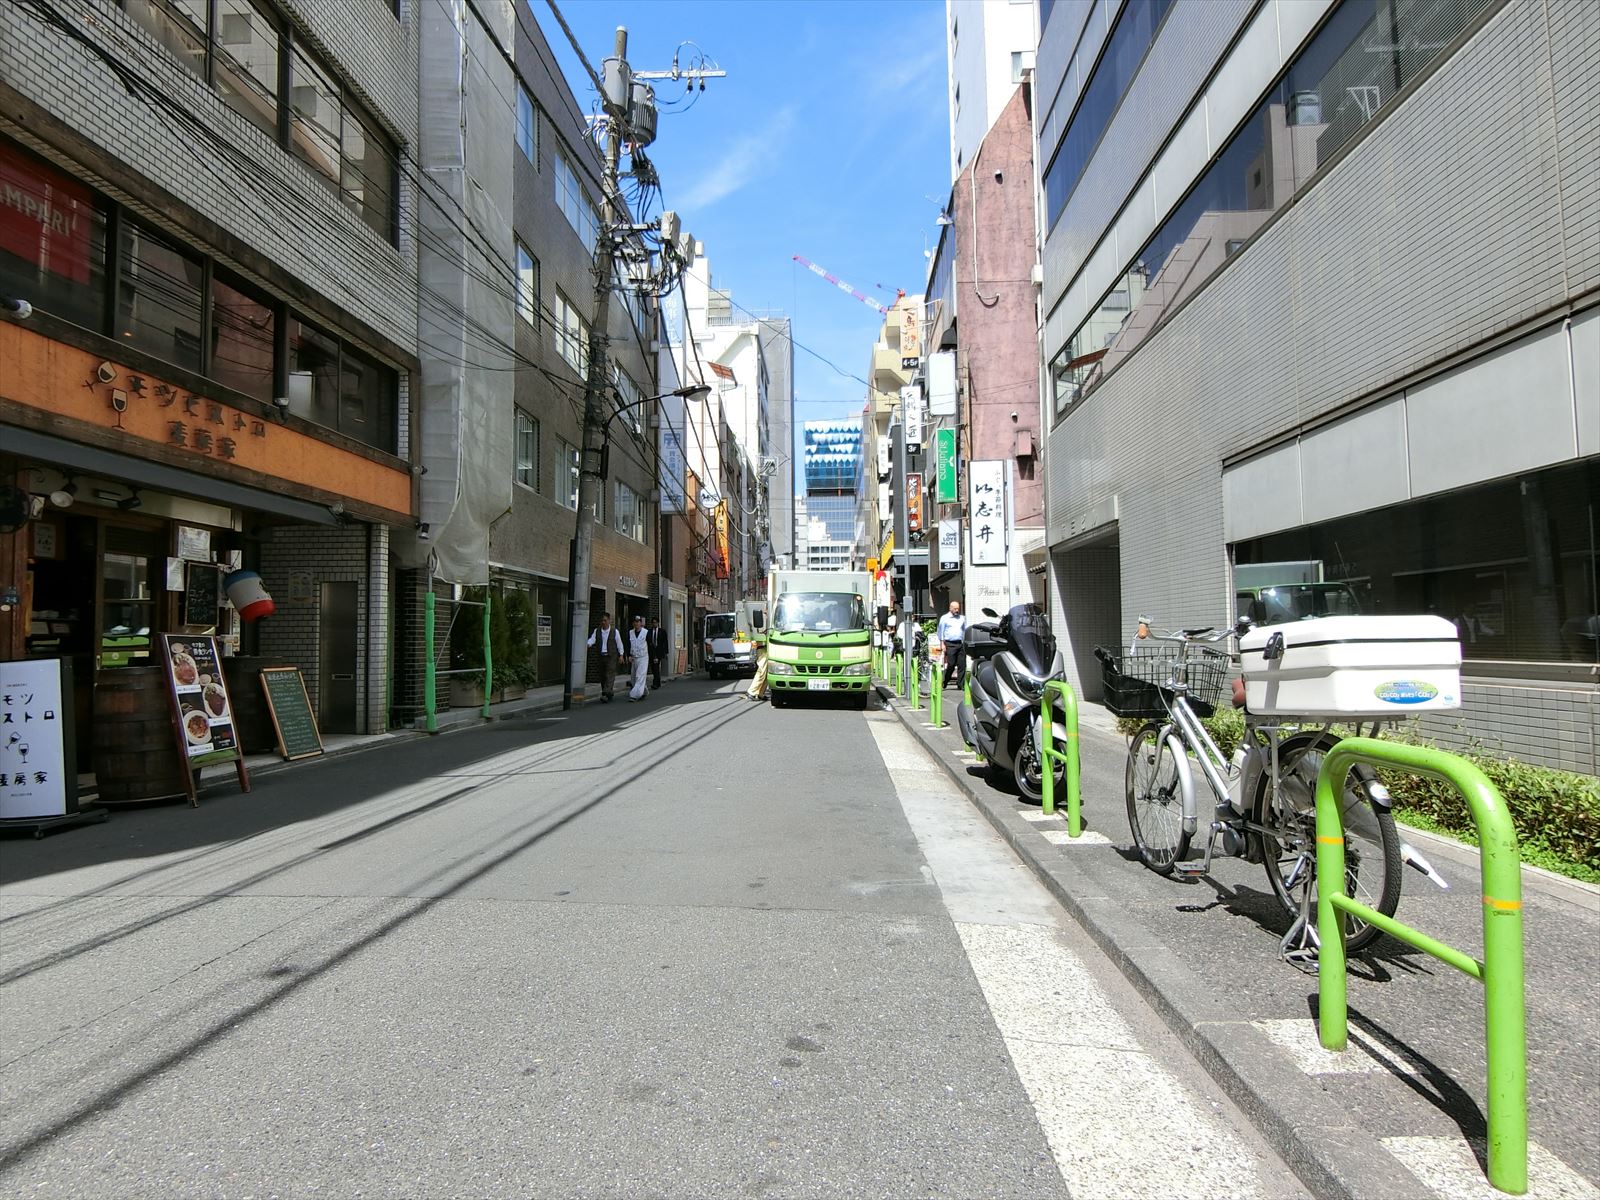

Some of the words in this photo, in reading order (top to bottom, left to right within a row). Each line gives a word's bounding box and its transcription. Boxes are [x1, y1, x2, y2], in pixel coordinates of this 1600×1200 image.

[0, 183, 70, 237] MPARI
[975, 483, 994, 544] 以志井
[3, 693, 34, 706] モツ
[3, 710, 55, 724] ストロ
